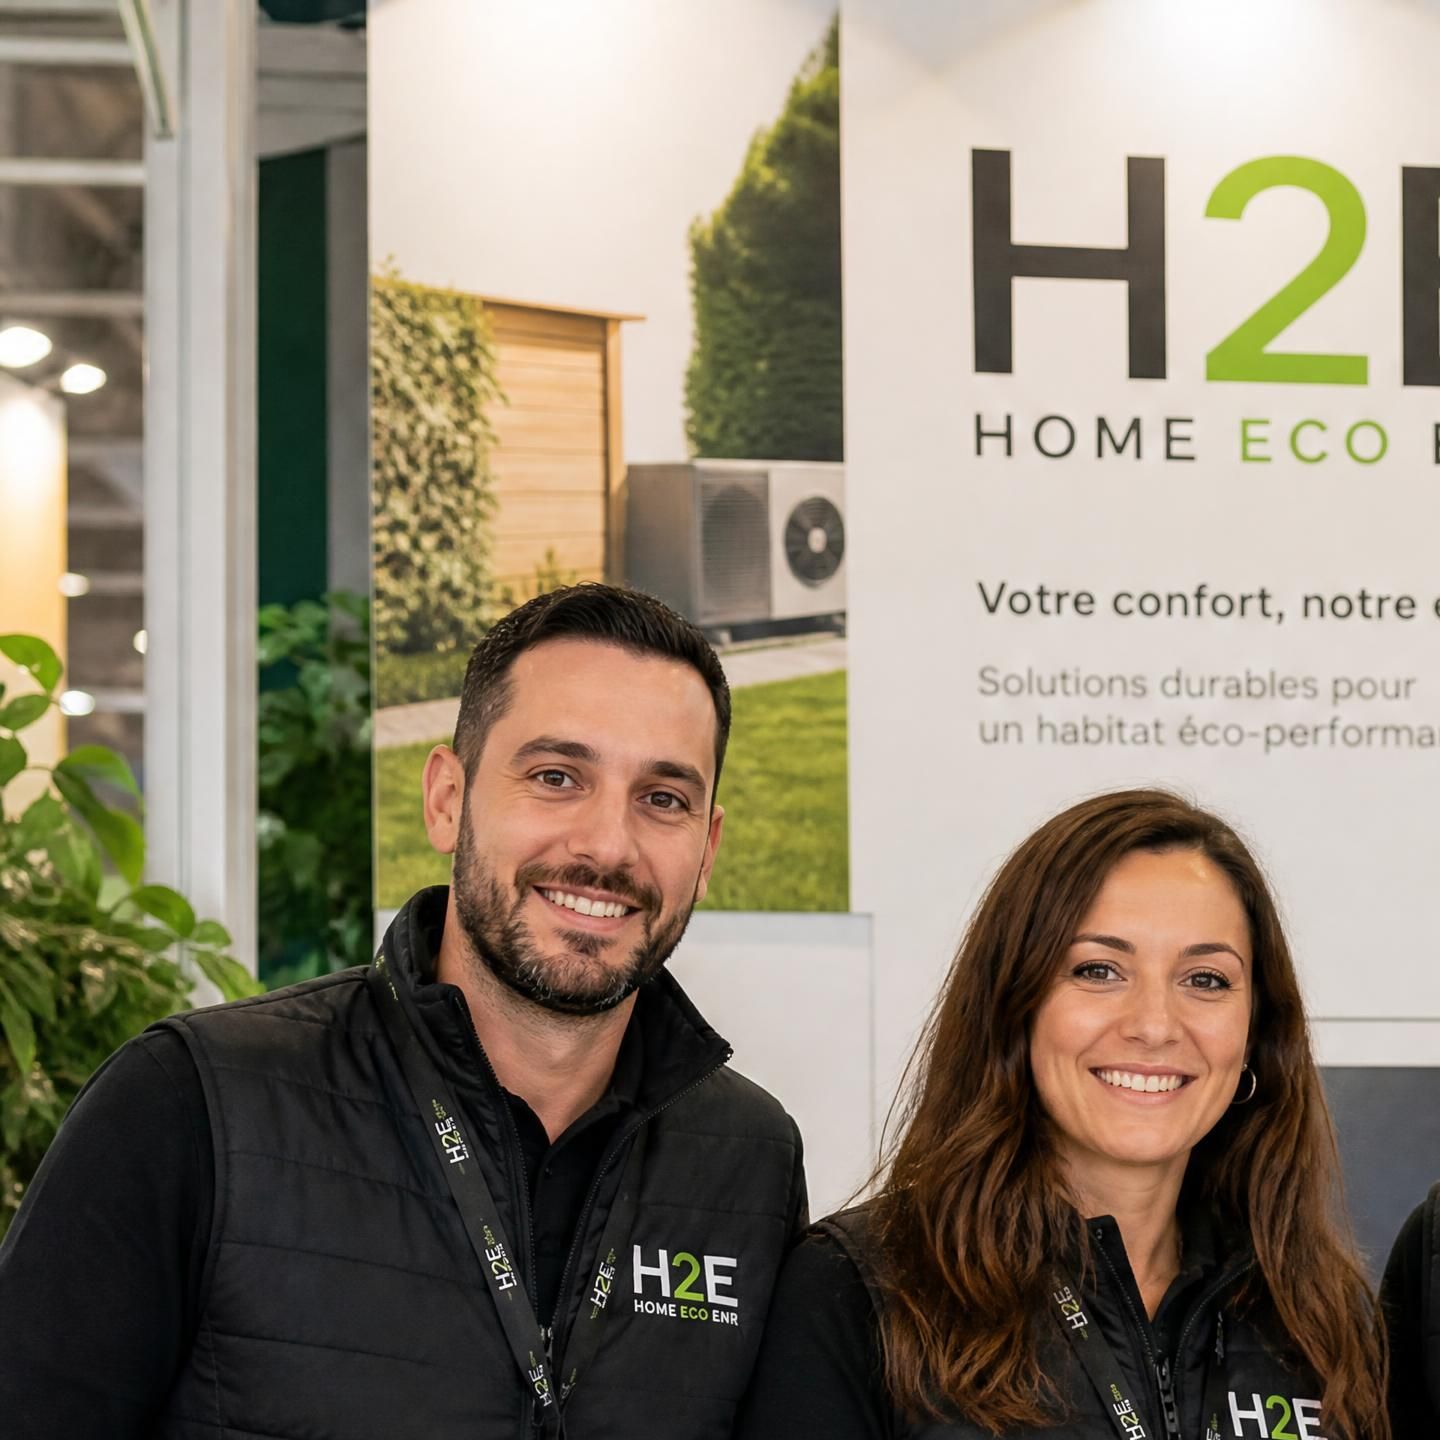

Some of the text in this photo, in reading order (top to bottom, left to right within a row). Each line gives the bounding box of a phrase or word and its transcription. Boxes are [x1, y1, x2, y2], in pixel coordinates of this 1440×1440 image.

[976, 414, 1196, 461] HOME
[1240, 418, 1389, 464] ECO
[978, 581, 1096, 617] Votre
[1113, 583, 1286, 625] confort,
[1303, 588, 1417, 621] notre
[978, 665, 1416, 706] Solutions durables pour
[979, 718, 1022, 744] un
[1037, 713, 1166, 746] habitat
[633, 1244, 738, 1307] H2E
[634, 1299, 739, 1326] HOME ECO ENR
